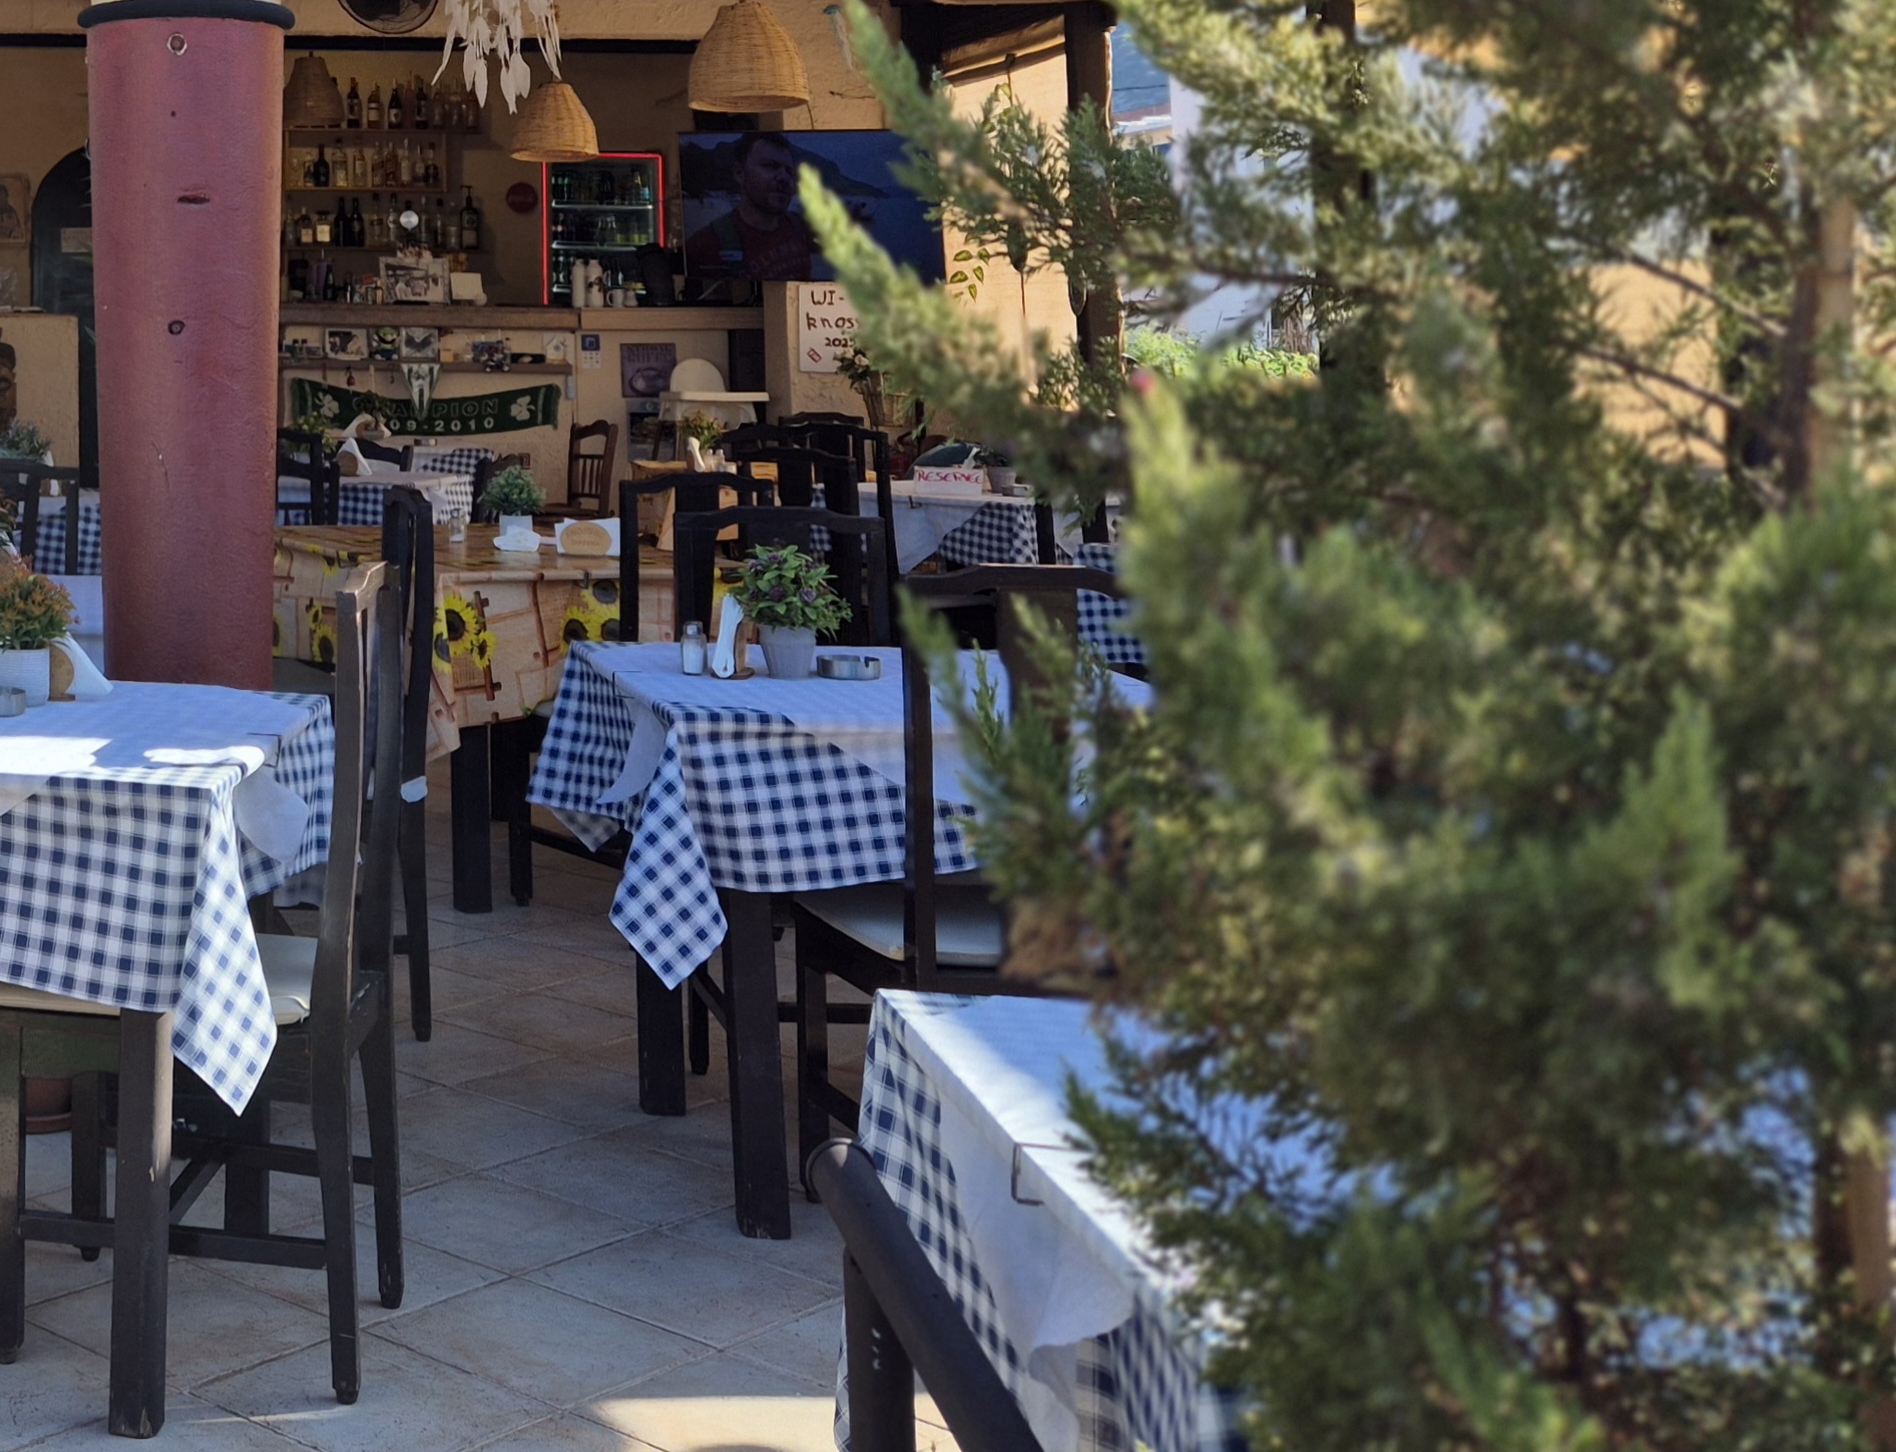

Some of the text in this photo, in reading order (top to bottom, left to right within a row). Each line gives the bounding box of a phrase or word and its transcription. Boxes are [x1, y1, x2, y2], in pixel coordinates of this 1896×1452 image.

[806, 311, 860, 331] knos
[352, 397, 499, 418] CAPION
[390, 417, 495, 432] 09-2010
